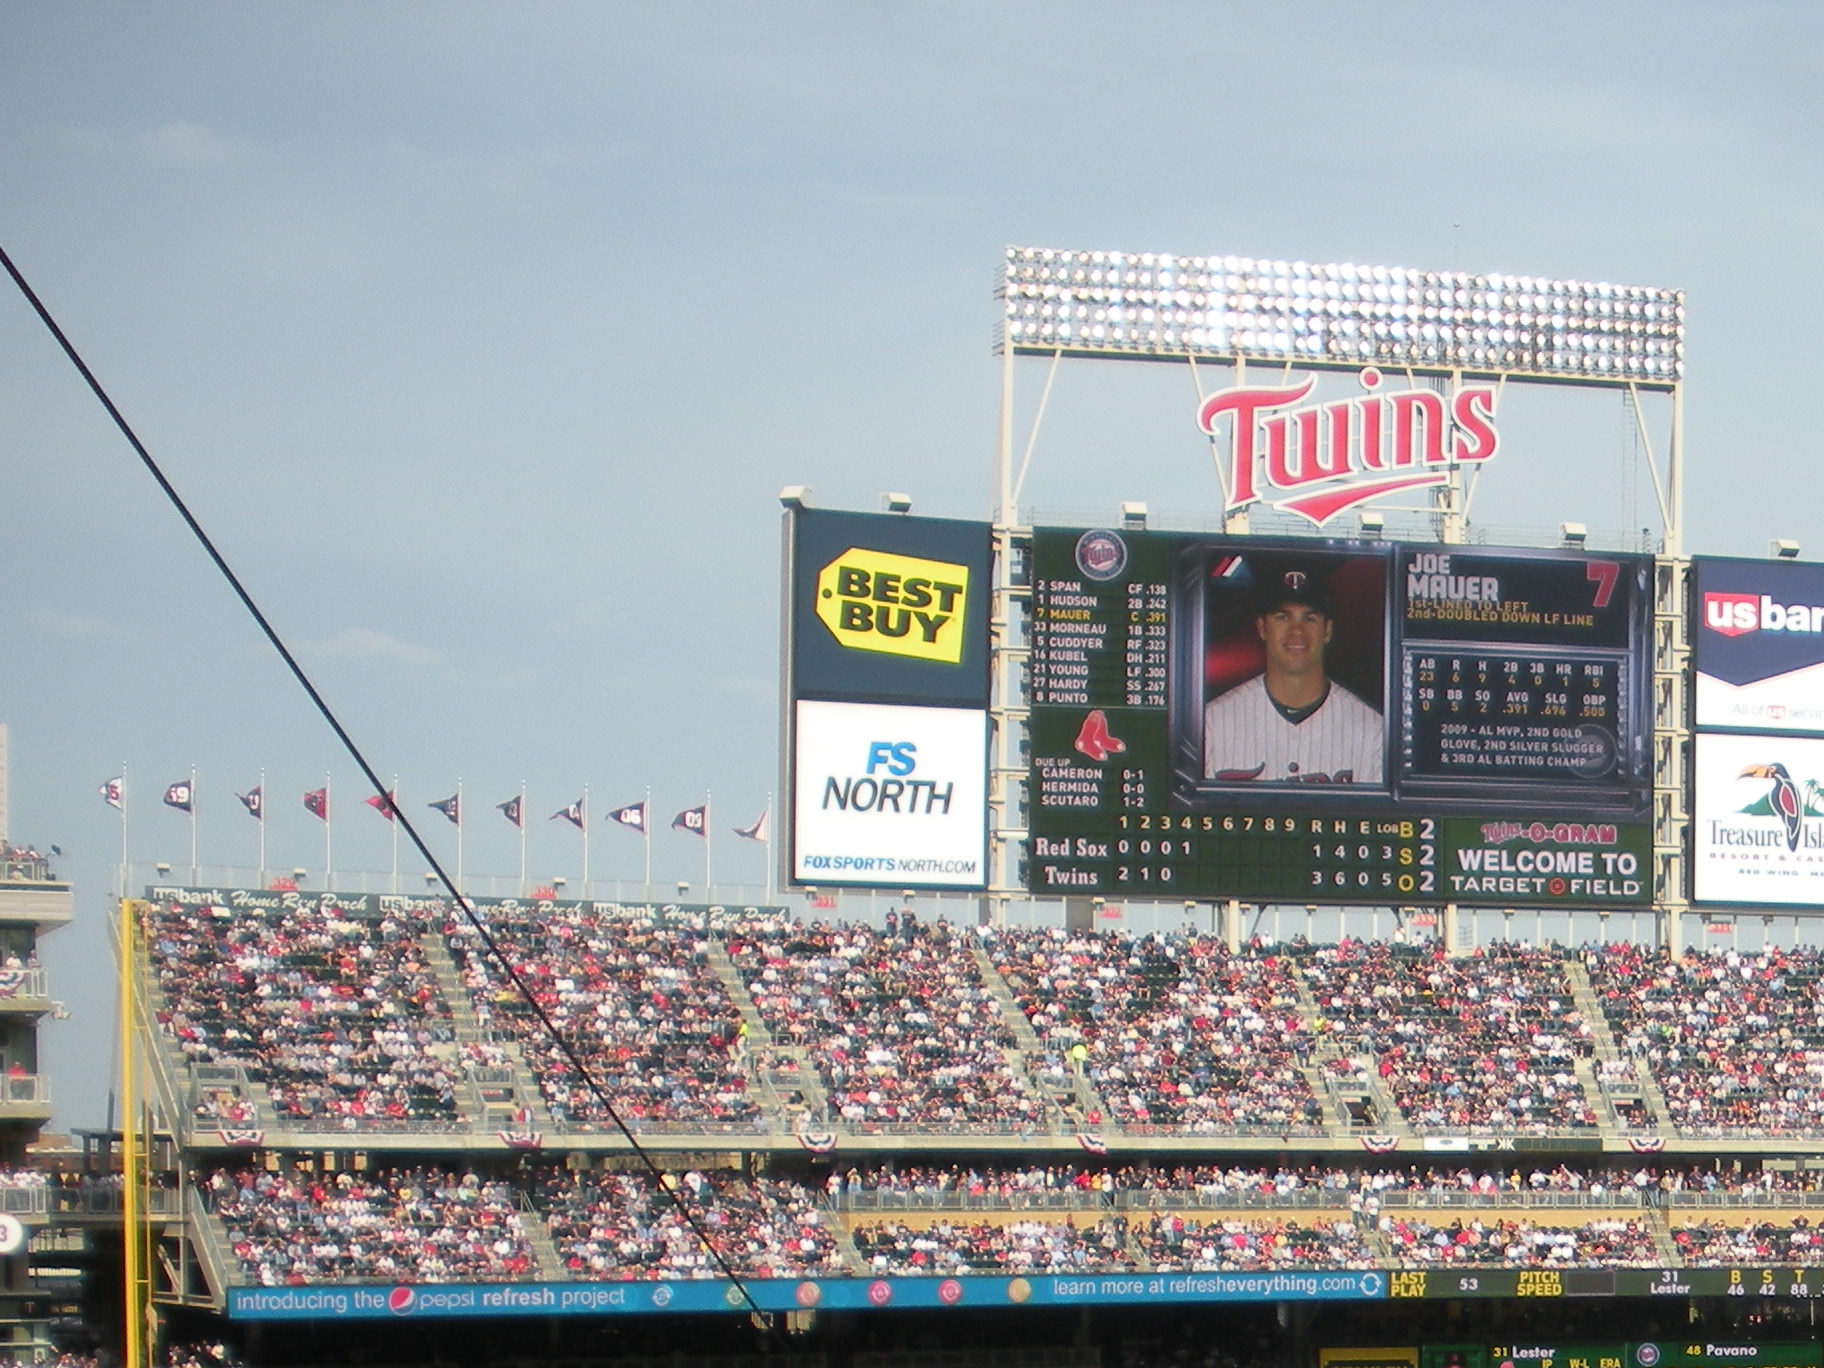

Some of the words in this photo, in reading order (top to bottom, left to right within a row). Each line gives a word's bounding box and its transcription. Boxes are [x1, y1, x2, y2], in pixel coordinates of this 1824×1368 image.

[1197, 366, 1500, 515] Twins
[1408, 554, 1450, 573] JOE
[836, 565, 963, 613] BEST
[1050, 581, 1080, 592] SPAN
[1407, 575, 1499, 600] MAUER
[1587, 561, 1620, 607] 7
[1050, 596, 1097, 607] HUDSON
[839, 599, 952, 643] BUY
[1050, 610, 1090, 620] MAUER
[1502, 611, 1540, 623] DOWN
[1544, 613, 1559, 625] LF
[1564, 614, 1593, 626] LINE
[1050, 624, 1106, 634] MORNEAU
[1050, 638, 1102, 648] CUDDYER
[1050, 651, 1087, 661] KUBEL
[1049, 665, 1088, 675] YOUNG
[1049, 678, 1088, 689] HARDY
[1049, 693, 1088, 703] PUNTO
[866, 741, 917, 776] FS
[1042, 768, 1102, 779] CAMERON
[1123, 769, 1144, 780] 0-1
[1042, 782, 1098, 793] HERMIDA
[1123, 783, 1144, 794] 0-0
[822, 776, 953, 815] NORTH
[1041, 796, 1098, 806] SCUTARO
[1123, 797, 1144, 808] 1-2
[1311, 820, 1322, 833] R
[1334, 821, 1346, 834] H
[1360, 821, 1369, 834] E
[1377, 824, 1398, 834] LOB
[1400, 822, 1413, 837] B
[1420, 819, 1434, 839] 2
[1708, 819, 1782, 846] Treasure
[1035, 838, 1070, 856] Red
[1076, 838, 1108, 857] Sox
[1119, 840, 1129, 853] 0
[1141, 840, 1150, 854] 0
[1161, 840, 1171, 854] 0
[1182, 841, 1190, 854] 1
[1313, 845, 1321, 857] 1
[1334, 845, 1346, 859] 4
[1358, 845, 1368, 859] 0
[1382, 846, 1392, 859] 3
[1400, 848, 1413, 865] S
[1420, 845, 1434, 865] 2
[1457, 848, 1592, 874] WELCOME
[1601, 853, 1637, 875] TO
[1044, 866, 1098, 885] Twins
[1119, 868, 1128, 880] 2
[1141, 868, 1149, 880] 1
[1161, 868, 1171, 880] 0
[1313, 871, 1322, 885] 3
[1334, 872, 1346, 885] 6
[1358, 872, 1368, 885] 0
[1382, 872, 1392, 886] 5
[1420, 872, 1434, 891] 2
[1450, 876, 1545, 893] TARGET
[1570, 879, 1640, 895] FIELD
[1391, 1272, 1426, 1284] LAST
[1520, 1272, 1560, 1283] PITCH
[1662, 1271, 1678, 1282] 31
[1054, 1278, 1094, 1296] learn
[1101, 1280, 1142, 1295] more
[1149, 1277, 1164, 1294] at
[1169, 1274, 1355, 1297] refresheverything.com
[1459, 1278, 1478, 1290] 53
[1517, 1284, 1561, 1296] SPEED
[1651, 1283, 1690, 1294] Lester
[1390, 1284, 1426, 1297] PLAY
[236, 1289, 347, 1313] introducing
[354, 1289, 385, 1309] the
[419, 1291, 475, 1312] pepsi
[483, 1288, 555, 1307] refresh
[562, 1287, 625, 1308] project
[1493, 1348, 1508, 1357] 31
[1512, 1347, 1555, 1358] Lester
[1687, 1346, 1701, 1355] 48
[1706, 1345, 1757, 1356] Pavano
